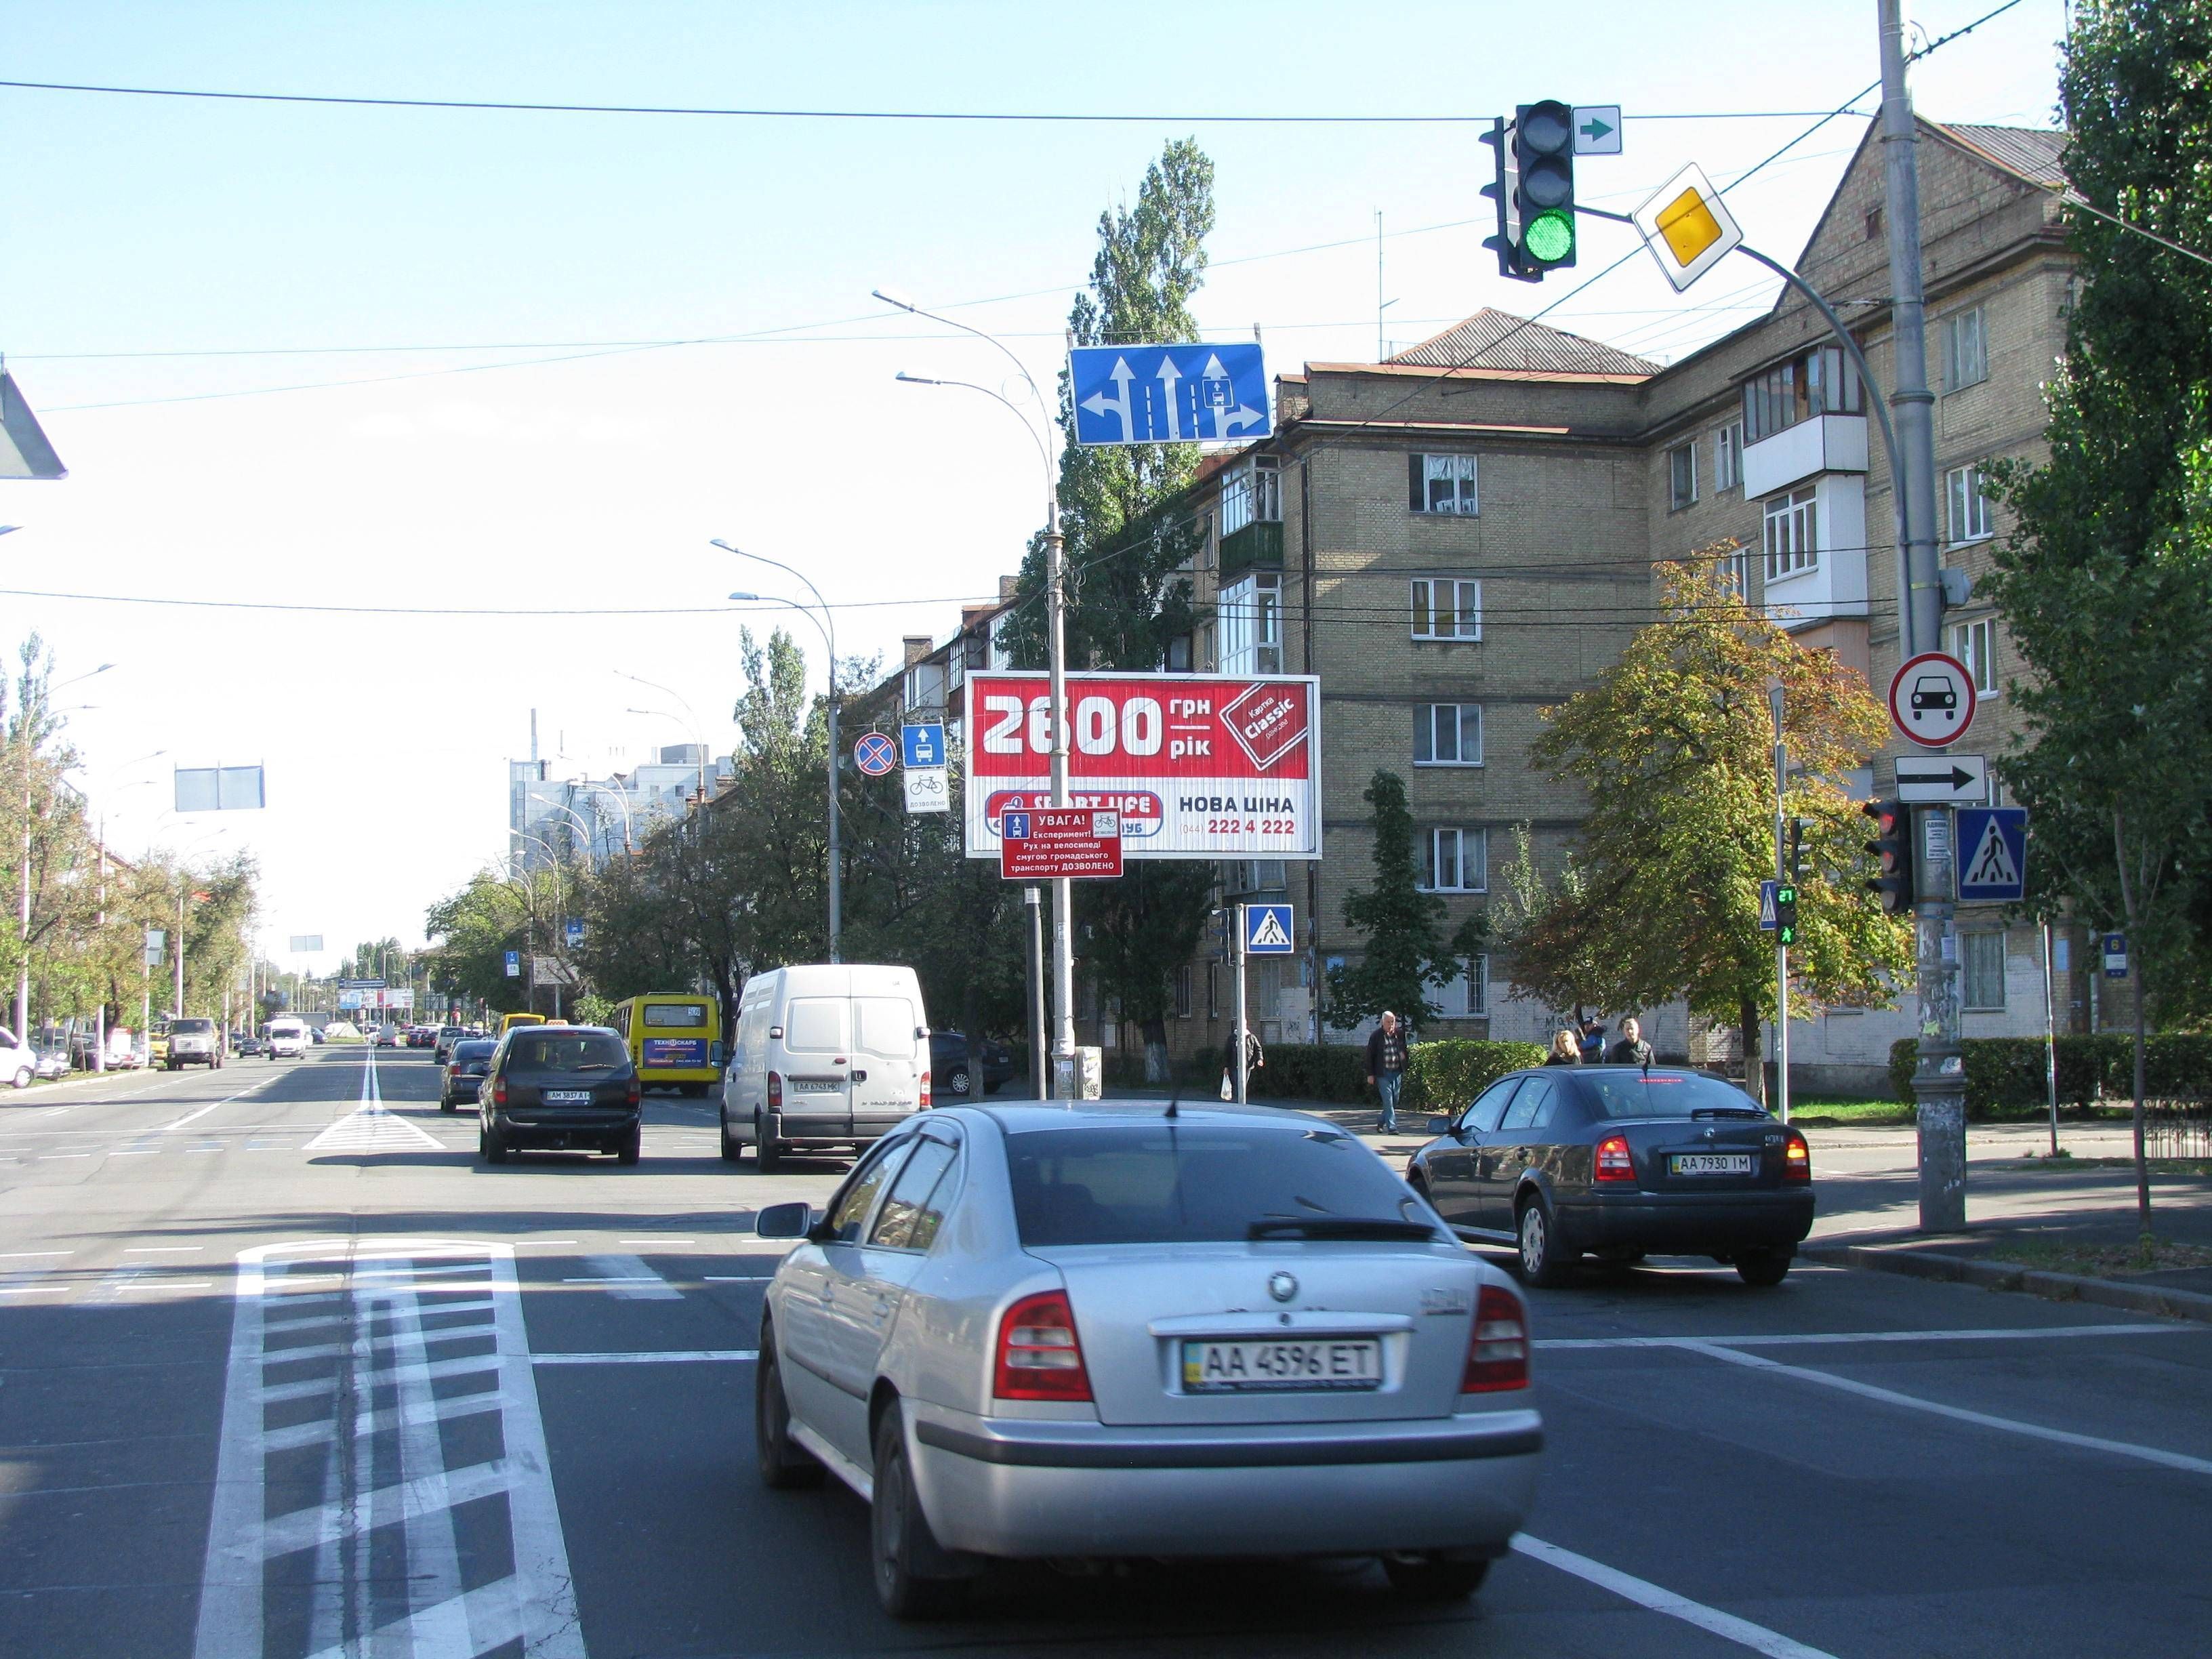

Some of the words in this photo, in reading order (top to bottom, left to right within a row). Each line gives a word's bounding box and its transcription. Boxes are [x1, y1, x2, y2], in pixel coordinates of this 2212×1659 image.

[1170, 699, 1210, 718] грн
[1248, 697, 1274, 718] Картка
[983, 695, 1162, 756] 2600
[1245, 698, 1294, 739] Classic
[1170, 736, 1211, 759] рік
[1180, 796, 1237, 812] НОВА
[1244, 797, 1294, 813] ЦІНА
[1039, 815, 1085, 826] УВАГА!
[1179, 824, 1204, 835] (044)
[1208, 819, 1240, 834] 222
[1245, 819, 1255, 834] 4
[1262, 820, 1294, 834] 222
[1033, 830, 1091, 840] Експеримент!
[1023, 842, 1038, 851] Рух
[1054, 840, 1101, 850] велосипеді
[1016, 854, 1048, 862] смугою
[1050, 853, 1109, 861] громадського
[1010, 864, 1059, 874] транспорту
[1061, 862, 1114, 872] ДОЗВОЛЕНО
[1779, 890, 1793, 901] 27
[1681, 1158, 1698, 1170] AA
[1700, 1157, 1727, 1170] 7930
[1206, 1347, 1248, 1377] AA
[1256, 1345, 1320, 1376] 4596
[1332, 1345, 1371, 1375] ET
